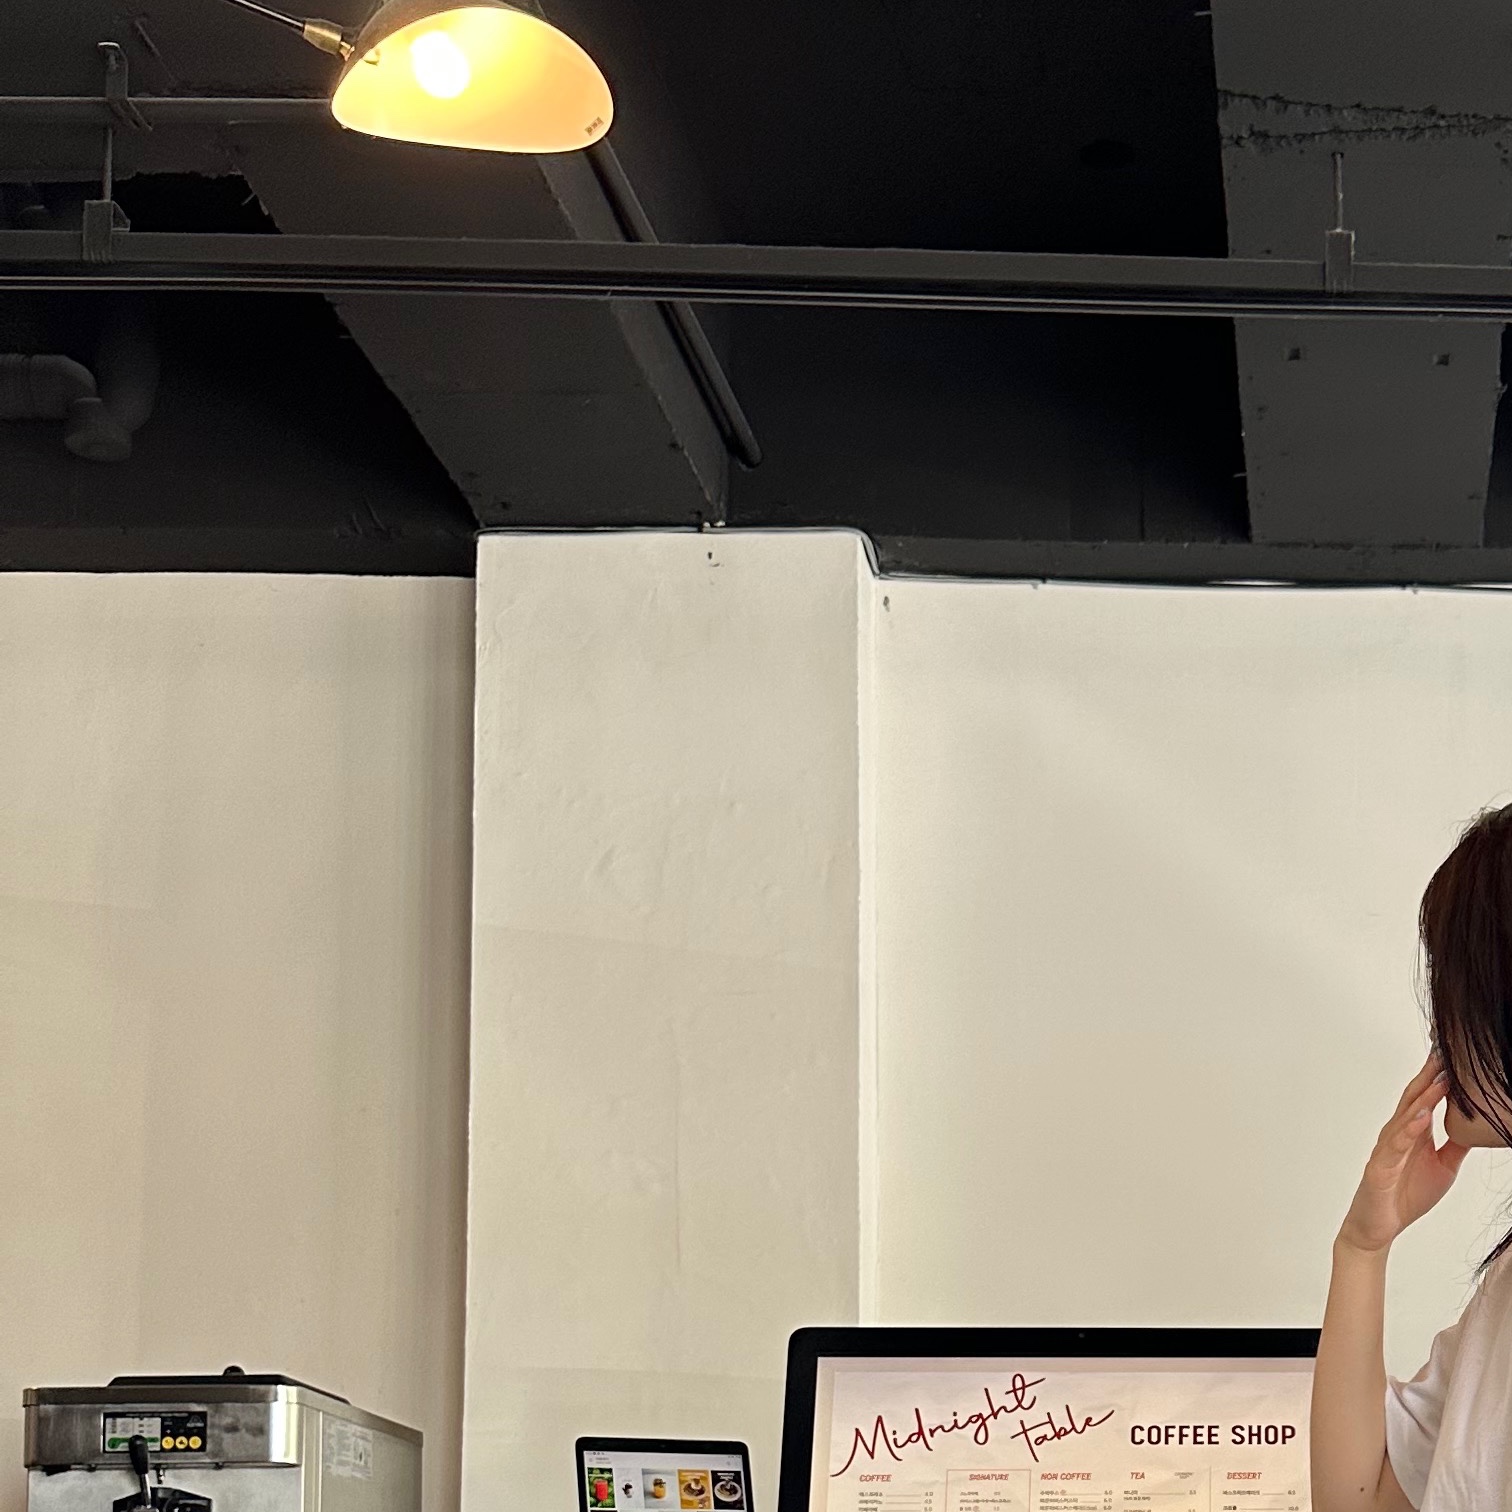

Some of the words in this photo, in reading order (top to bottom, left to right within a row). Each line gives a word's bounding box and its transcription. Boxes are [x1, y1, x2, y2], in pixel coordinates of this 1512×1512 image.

[830, 1373, 1046, 1477] Midnight
[1130, 1425, 1219, 1446] COFFEE
[1231, 1425, 1297, 1445] SHOP
[859, 1474, 892, 1482] COFFEE
[1130, 1472, 1145, 1480] TEA
[1227, 1472, 1262, 1480] DESSERT
